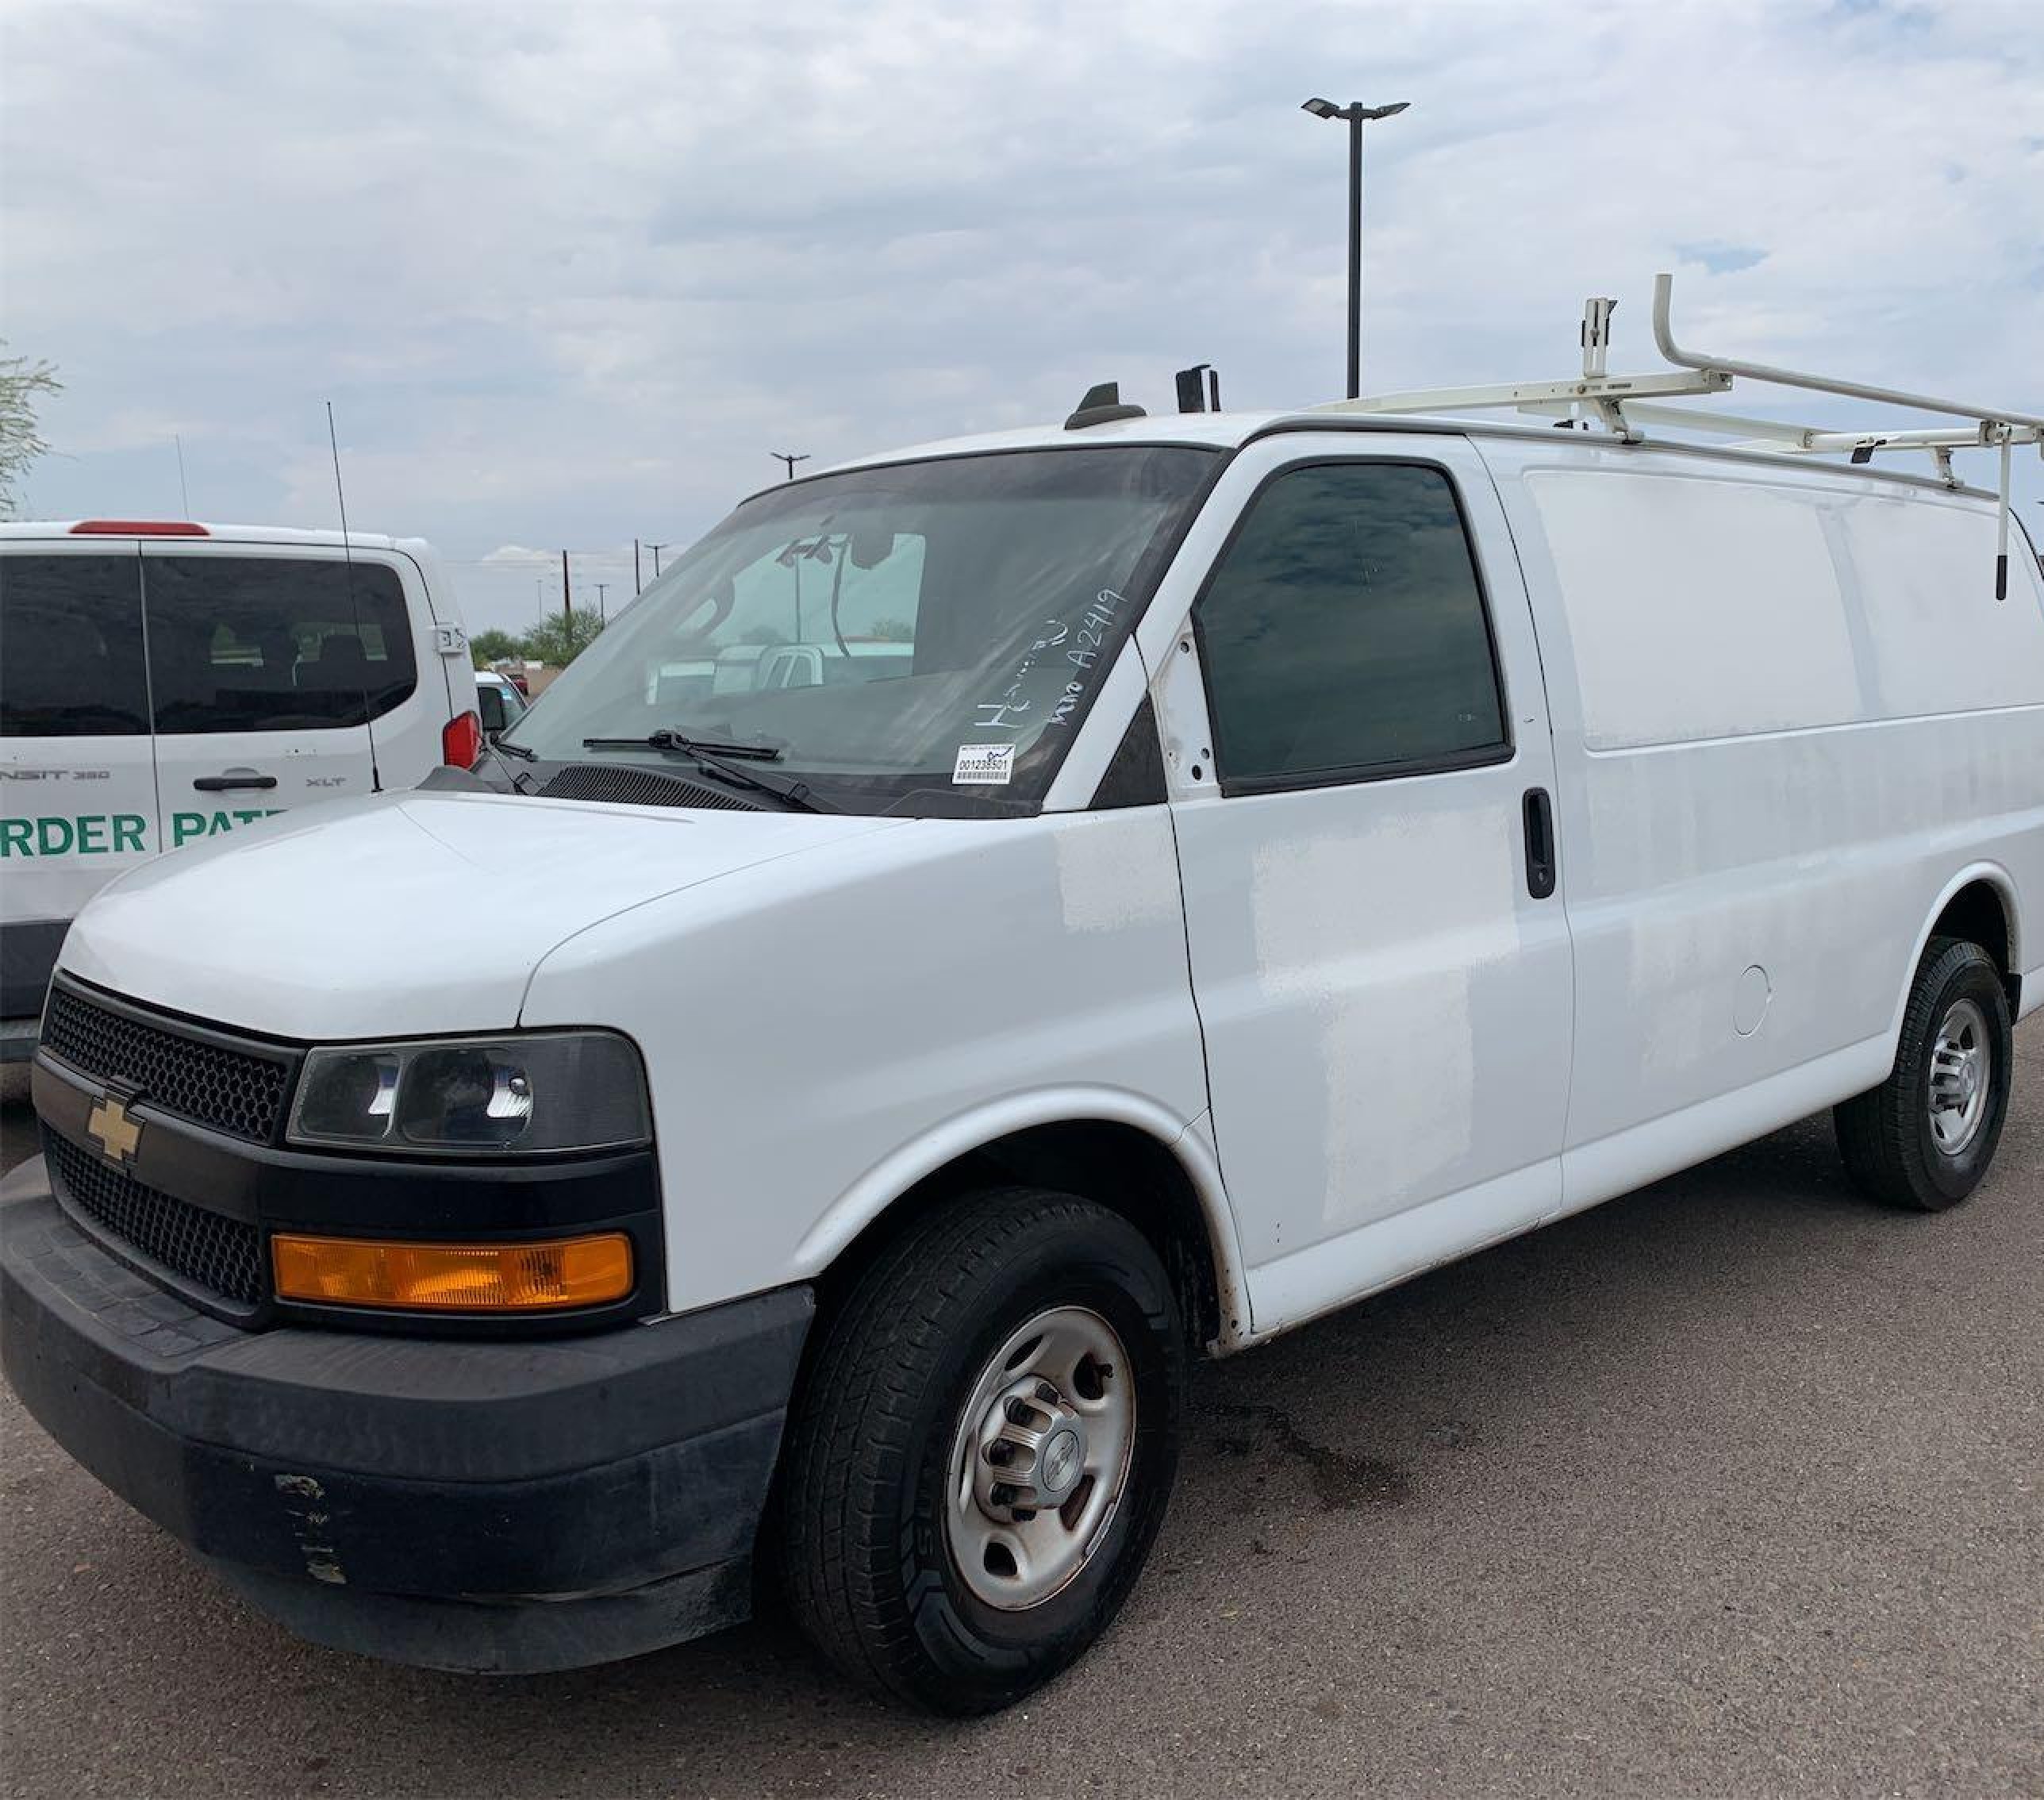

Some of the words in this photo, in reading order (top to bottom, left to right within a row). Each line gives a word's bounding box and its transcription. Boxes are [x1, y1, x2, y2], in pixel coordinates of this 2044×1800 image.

[1066, 589, 1128, 668] A2419
[305, 777, 347, 787] XLT
[0, 814, 145, 857] RDER
[172, 809, 290, 848] PAT
